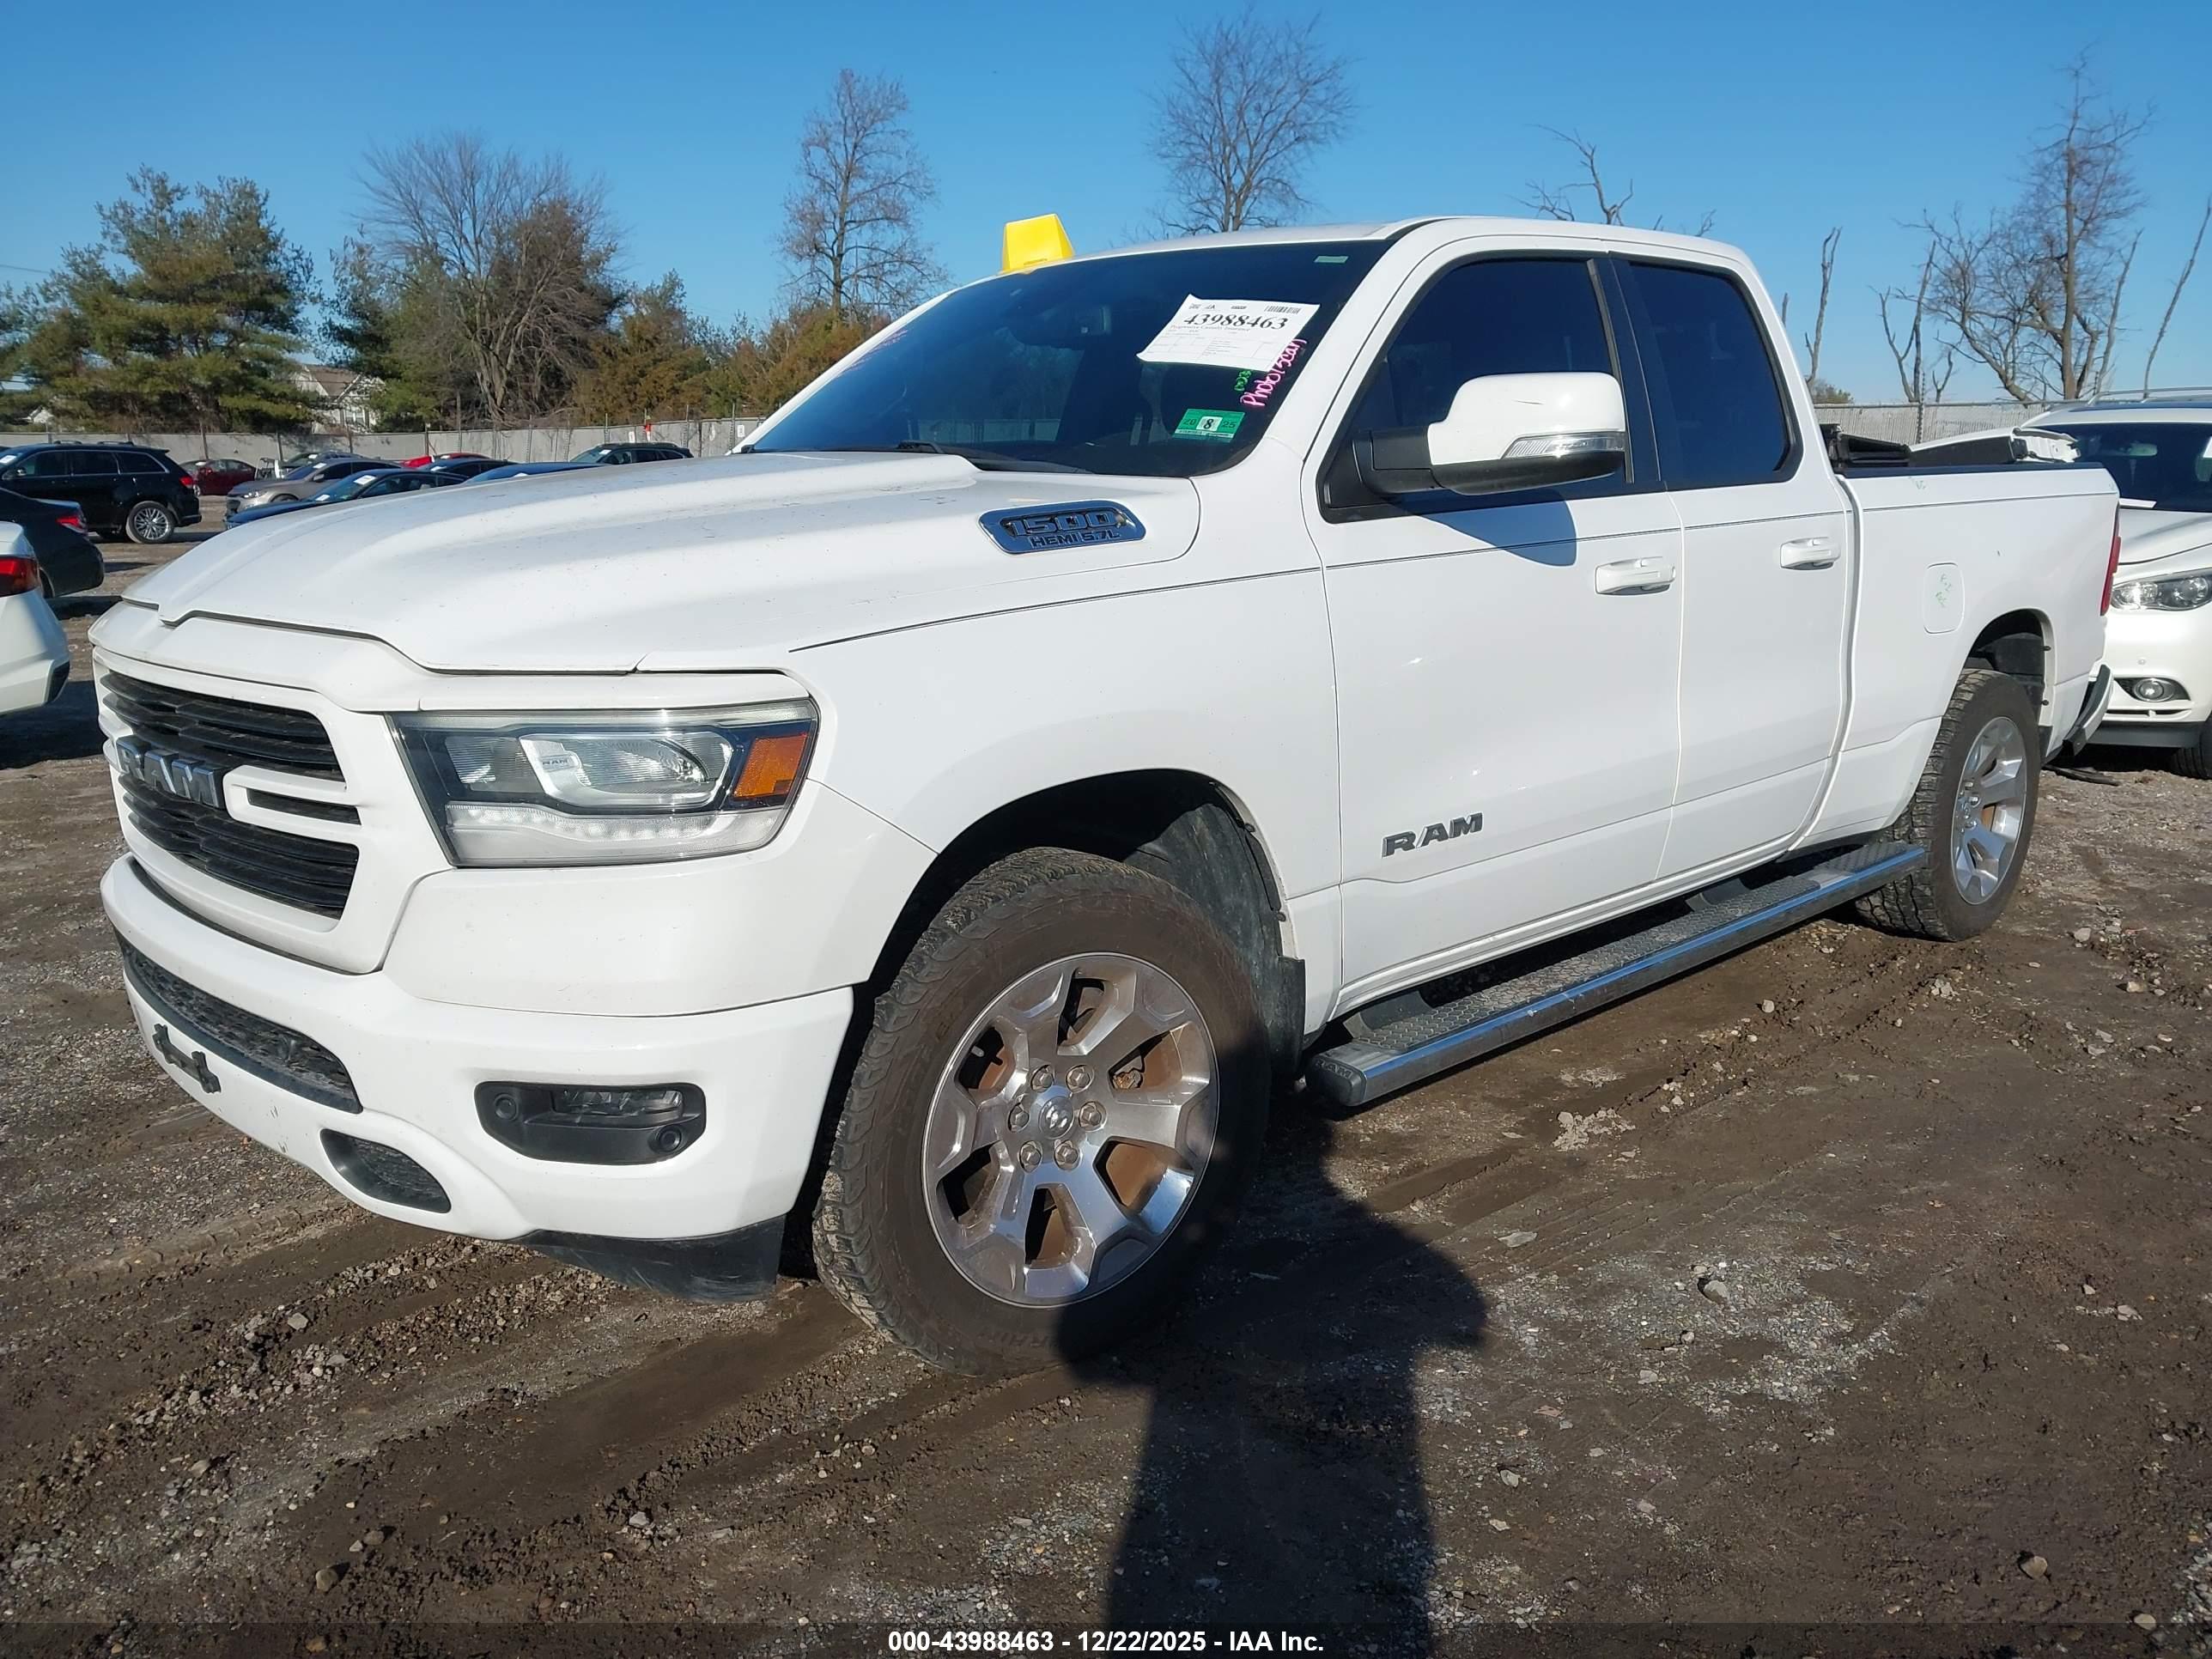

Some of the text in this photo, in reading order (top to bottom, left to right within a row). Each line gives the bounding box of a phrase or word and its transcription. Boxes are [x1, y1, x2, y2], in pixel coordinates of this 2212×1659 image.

[1184, 313, 1288, 330] 43988463
[1203, 418, 1214, 429] 8
[1009, 511, 1115, 537] 1500
[1030, 529, 1121, 549] HEMI 5.7L
[115, 738, 220, 808] RAM
[1381, 812, 1483, 858] RAM
